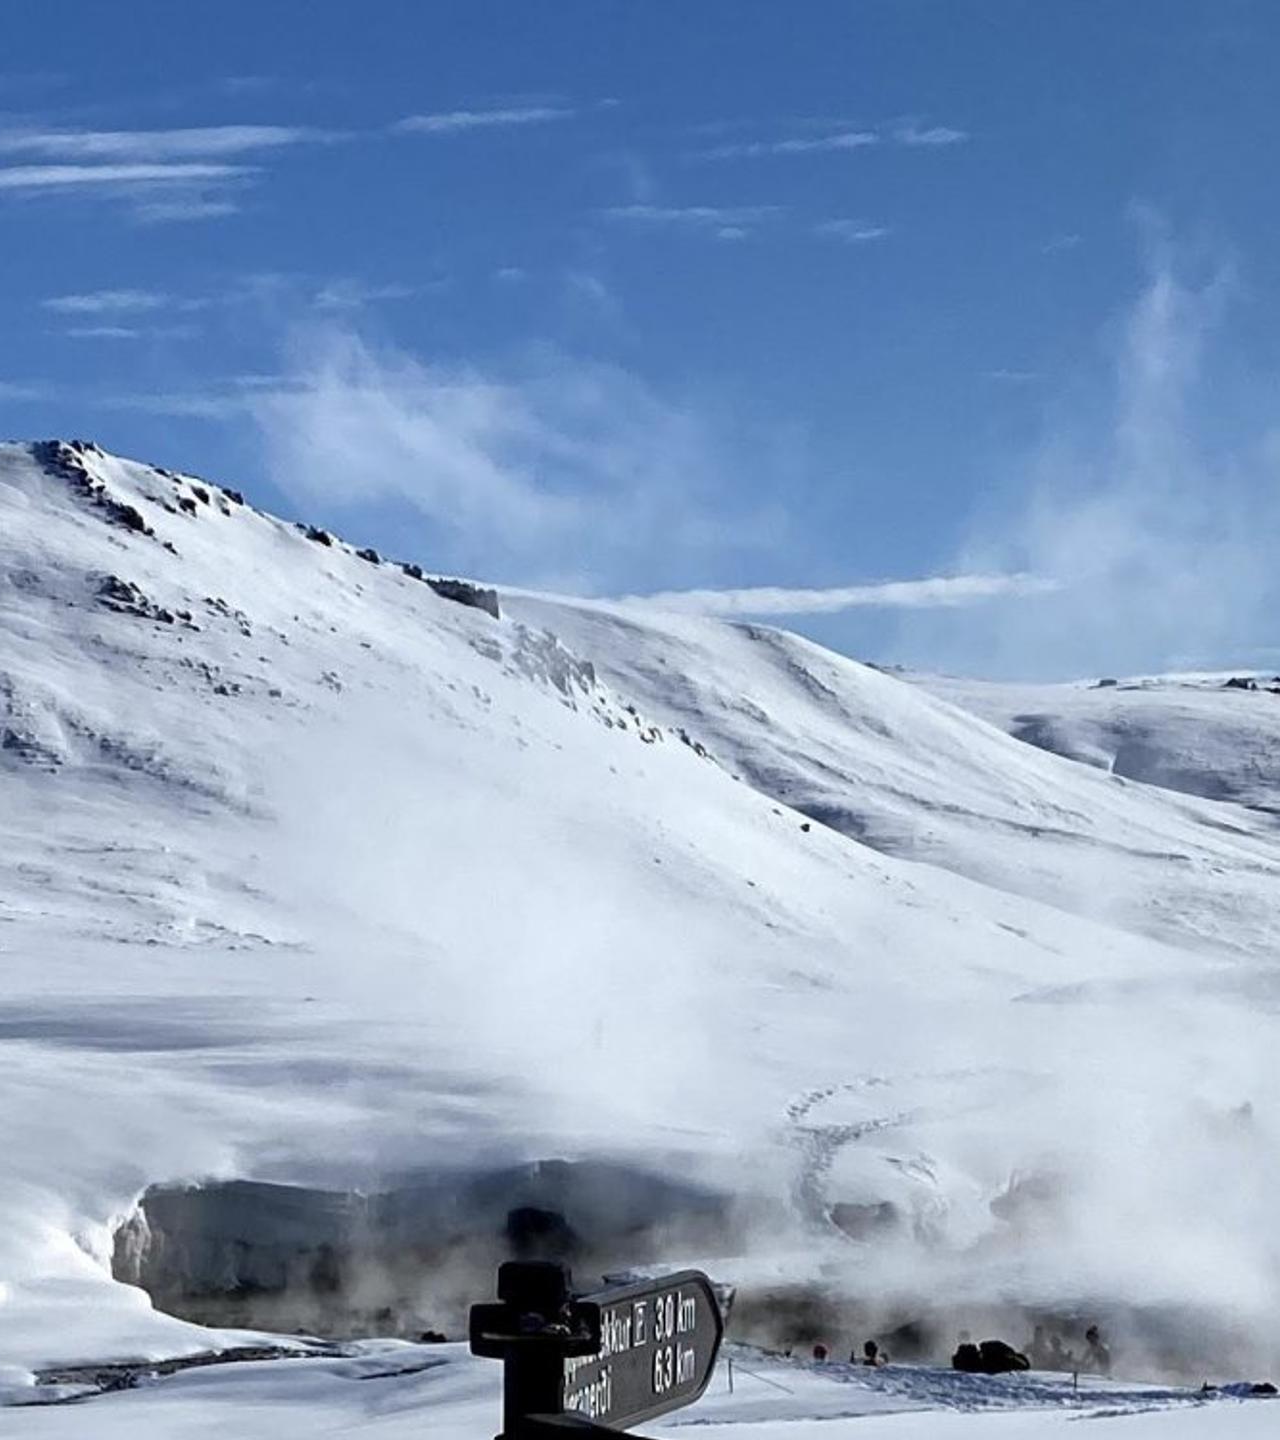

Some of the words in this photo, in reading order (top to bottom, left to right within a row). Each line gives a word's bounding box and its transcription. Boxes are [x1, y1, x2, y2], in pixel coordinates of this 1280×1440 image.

[677, 1292, 695, 1333] km
[654, 1346, 673, 1392] 6,3
[677, 1343, 695, 1385] km
